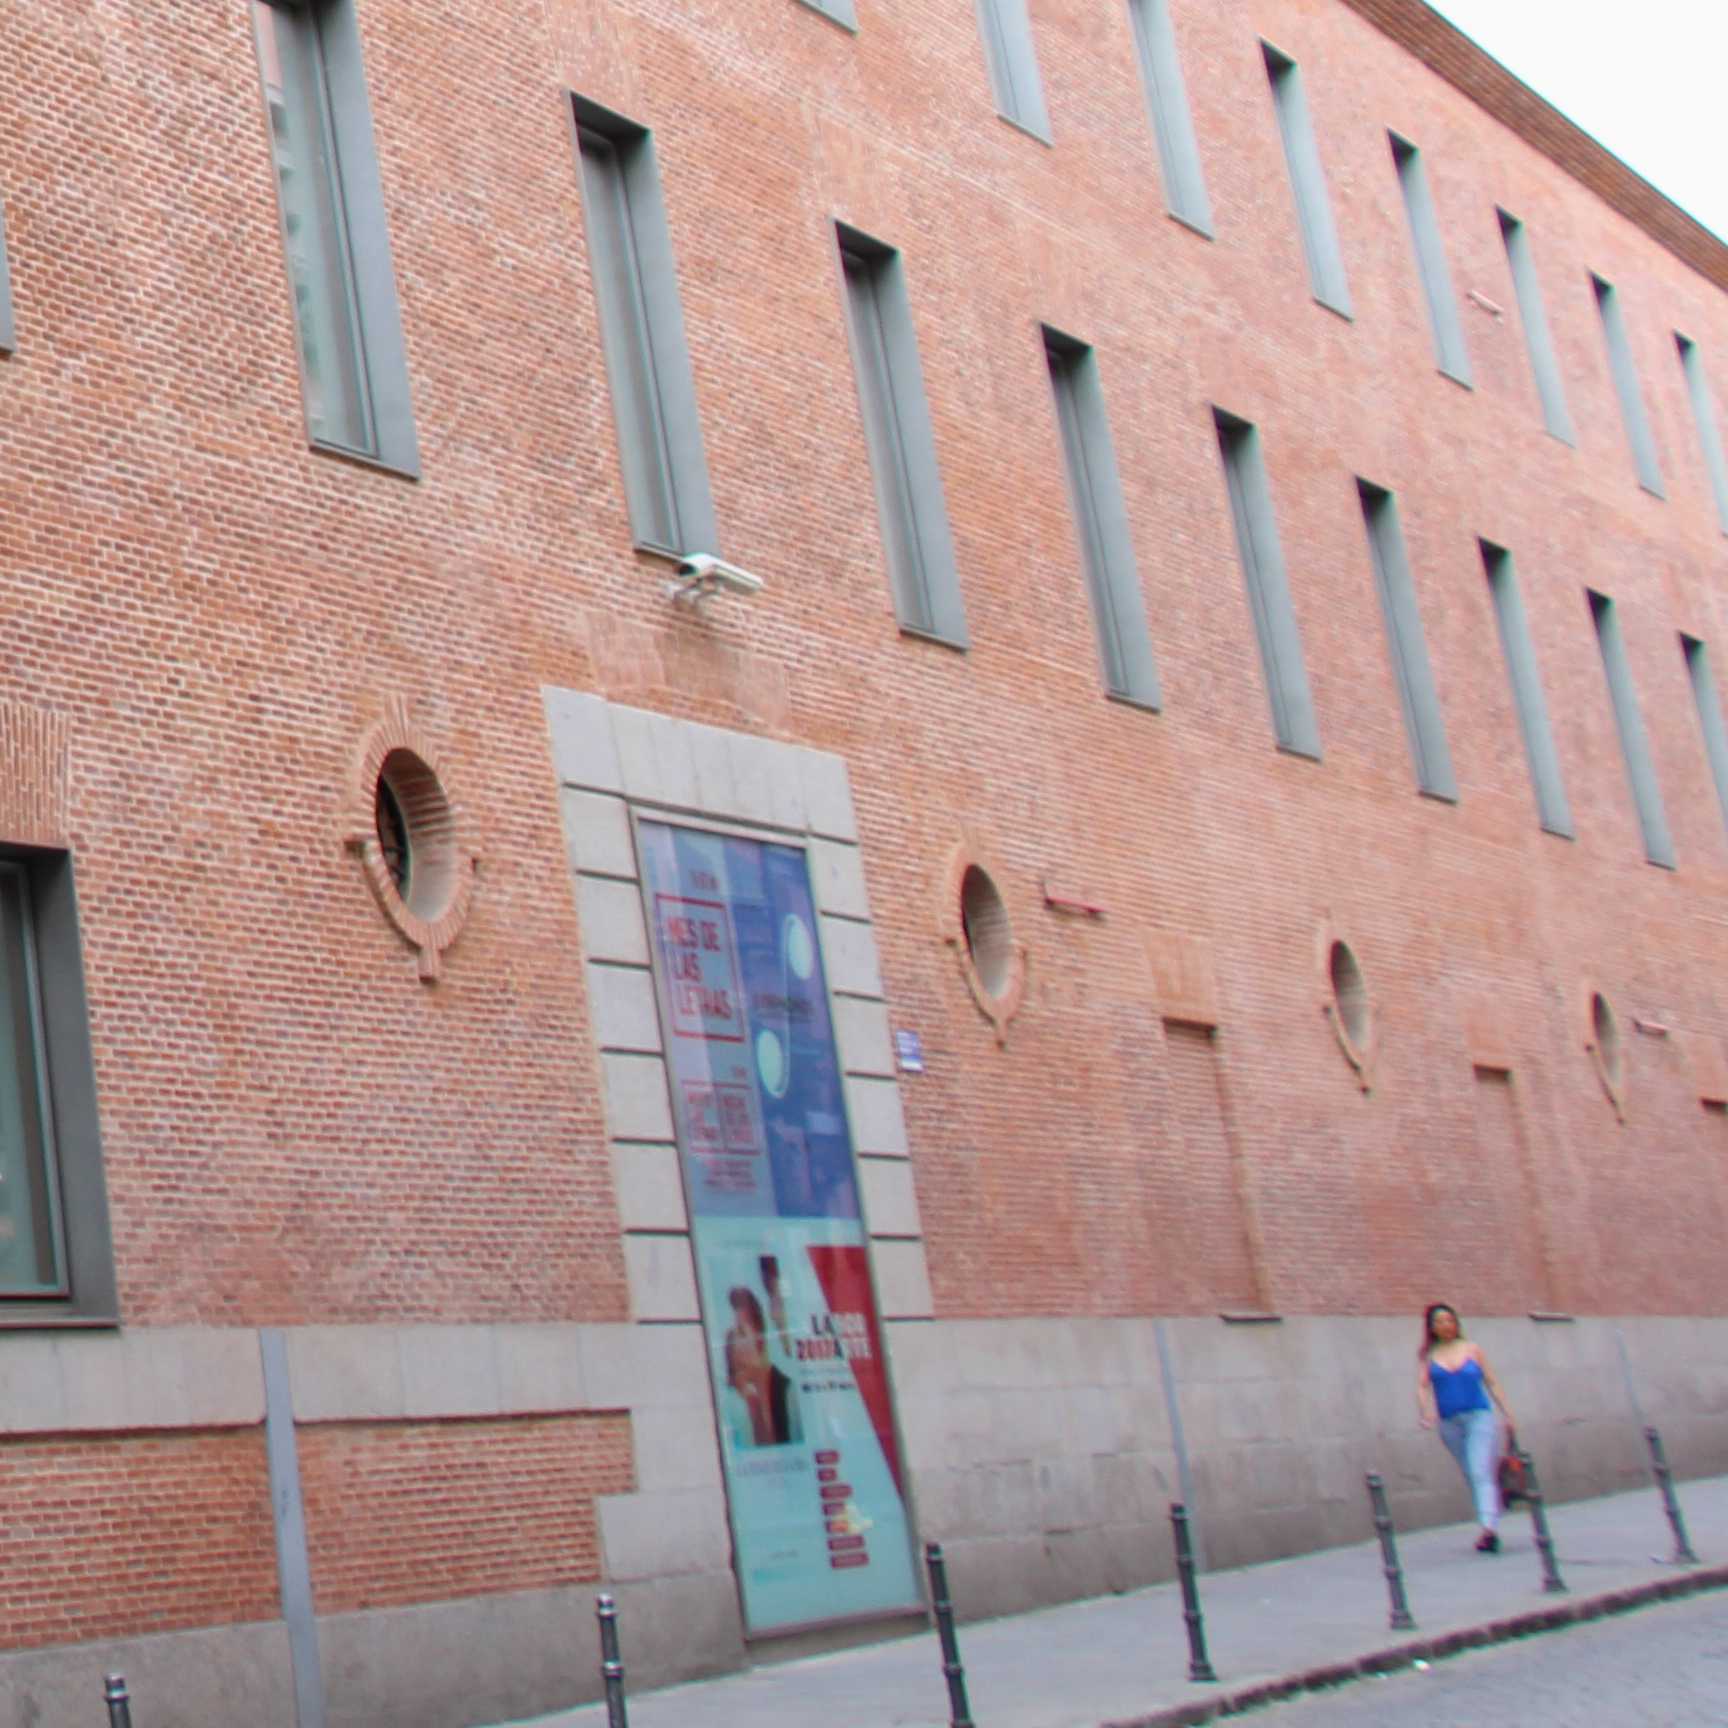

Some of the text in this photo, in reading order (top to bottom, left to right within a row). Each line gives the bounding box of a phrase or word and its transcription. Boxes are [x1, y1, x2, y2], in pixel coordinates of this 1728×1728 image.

[668, 917, 722, 953] MES DE
[673, 952, 702, 983] LAS
[679, 984, 733, 1020] LETRAS
